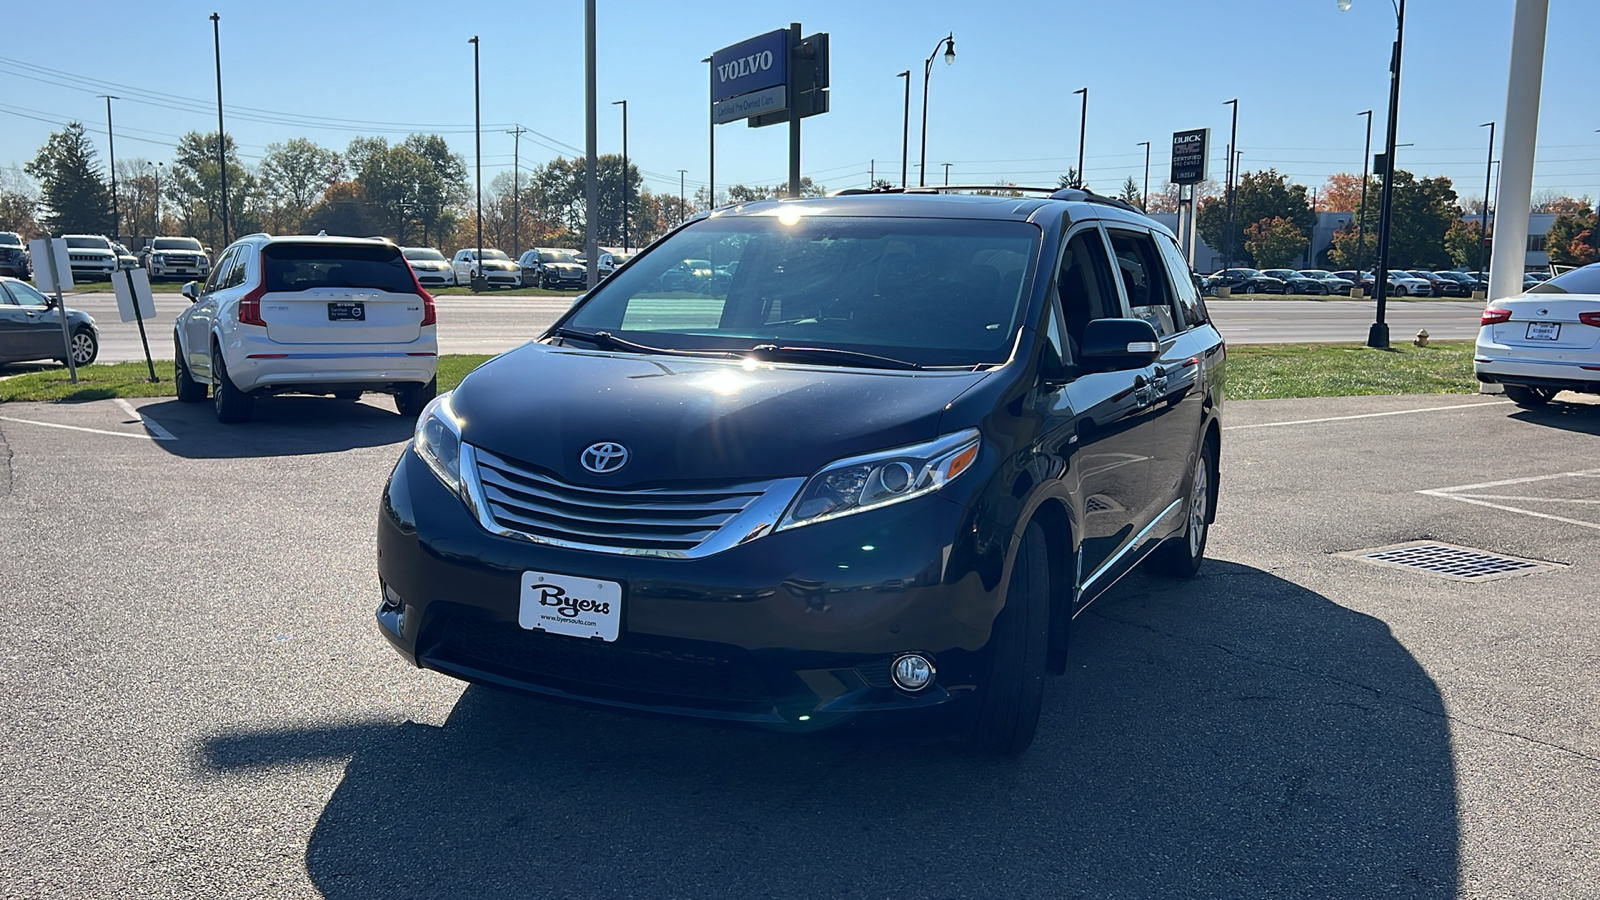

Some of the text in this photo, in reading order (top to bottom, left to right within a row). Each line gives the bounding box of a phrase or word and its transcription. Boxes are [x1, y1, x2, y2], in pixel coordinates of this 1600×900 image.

[717, 50, 773, 83] VOLVO
[717, 104, 734, 117] Certified
[761, 95, 774, 106] Cars
[1174, 134, 1201, 144] BUICK
[1175, 143, 1200, 154] GMC
[1173, 154, 1201, 163] CERTIFIED
[531, 584, 610, 617] Byers
[540, 614, 597, 627] www.byersauto.com
